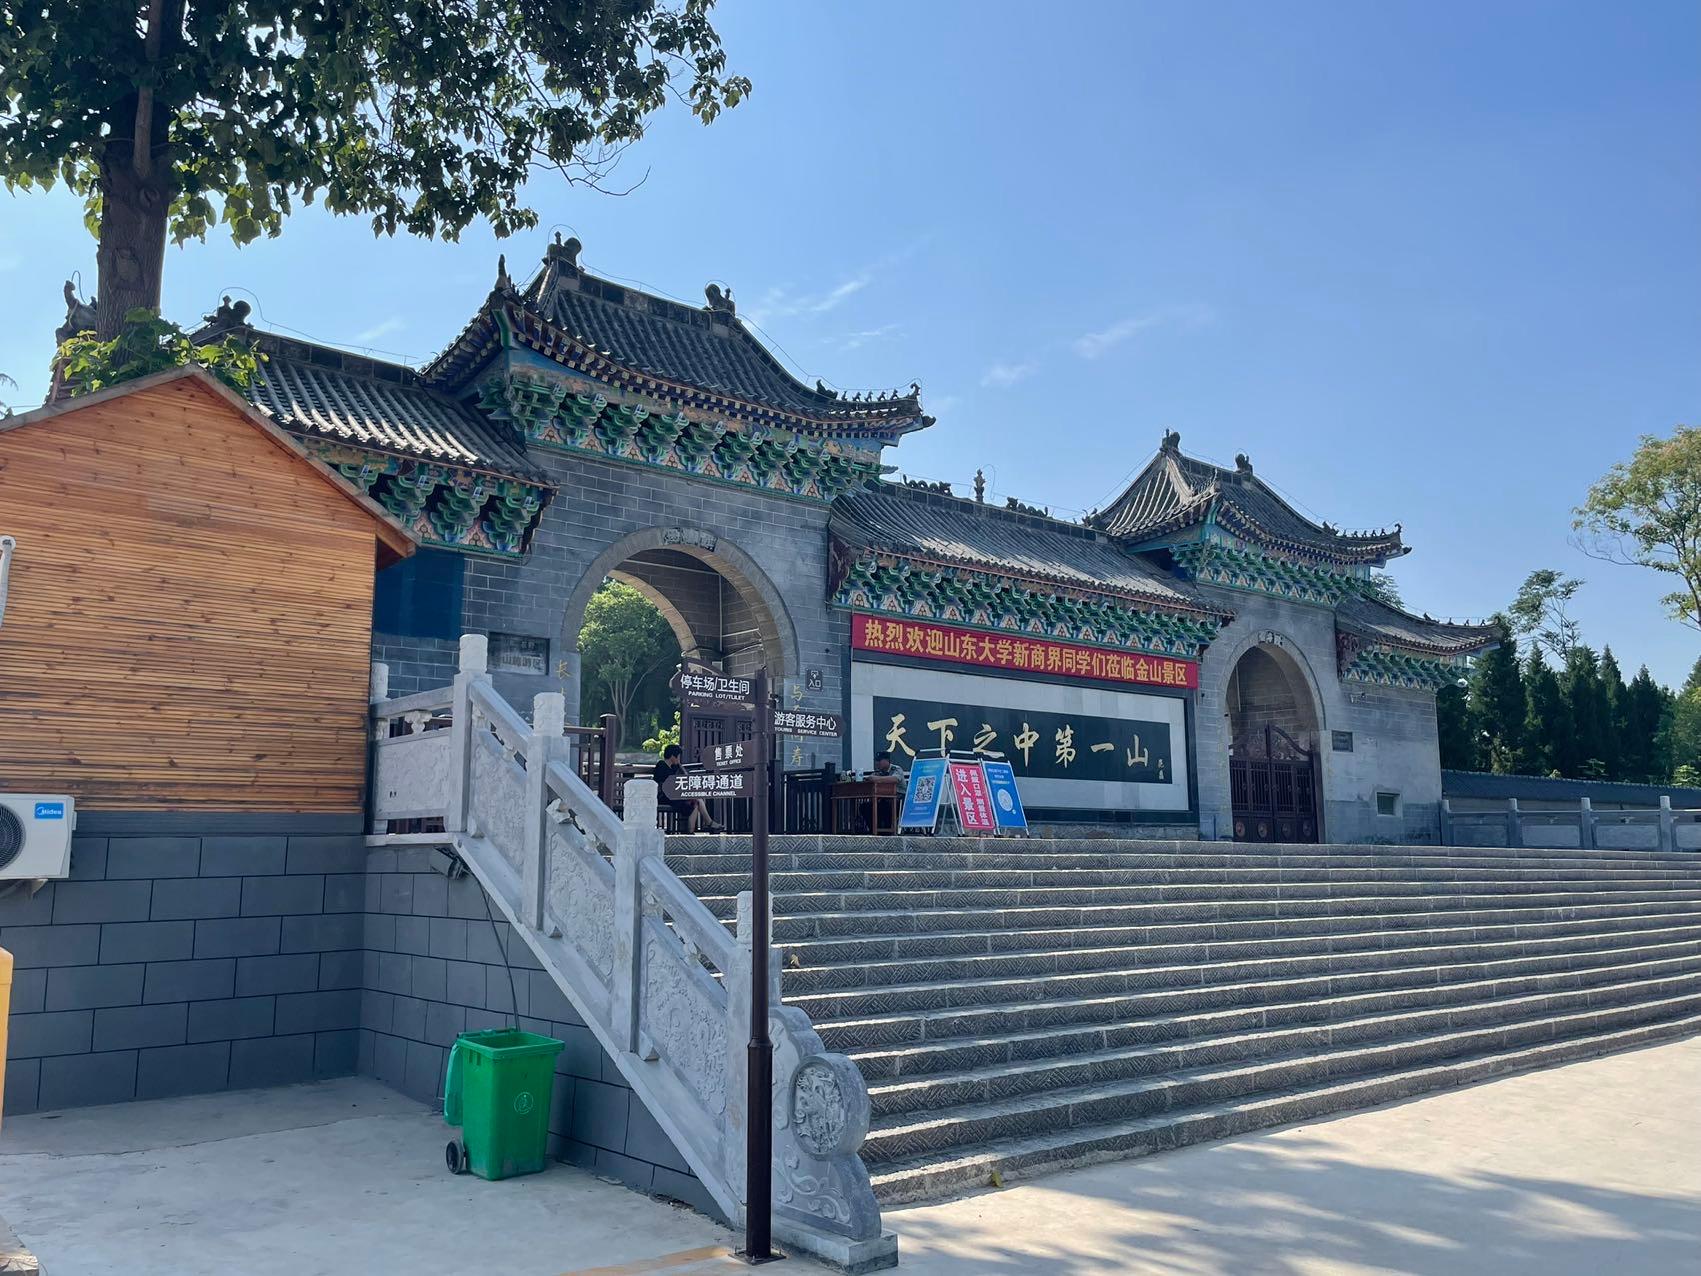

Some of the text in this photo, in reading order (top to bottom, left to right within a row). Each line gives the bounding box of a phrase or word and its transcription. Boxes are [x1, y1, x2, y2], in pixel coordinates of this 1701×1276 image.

[864, 619, 1188, 686] 热烈欢迎山东大学新商界同学们莅临金山景区
[680, 673, 750, 695] 停车场/卫生间
[808, 678, 821, 688] 入口
[688, 690, 713, 698] PARKING
[774, 711, 837, 731] 游客服务中心
[885, 713, 1149, 768] 天下之中第一山
[714, 743, 743, 761] 售票处
[674, 773, 744, 790] 无障碍通道
[955, 768, 979, 825] 进入景区
[38, 806, 62, 815] Midea
